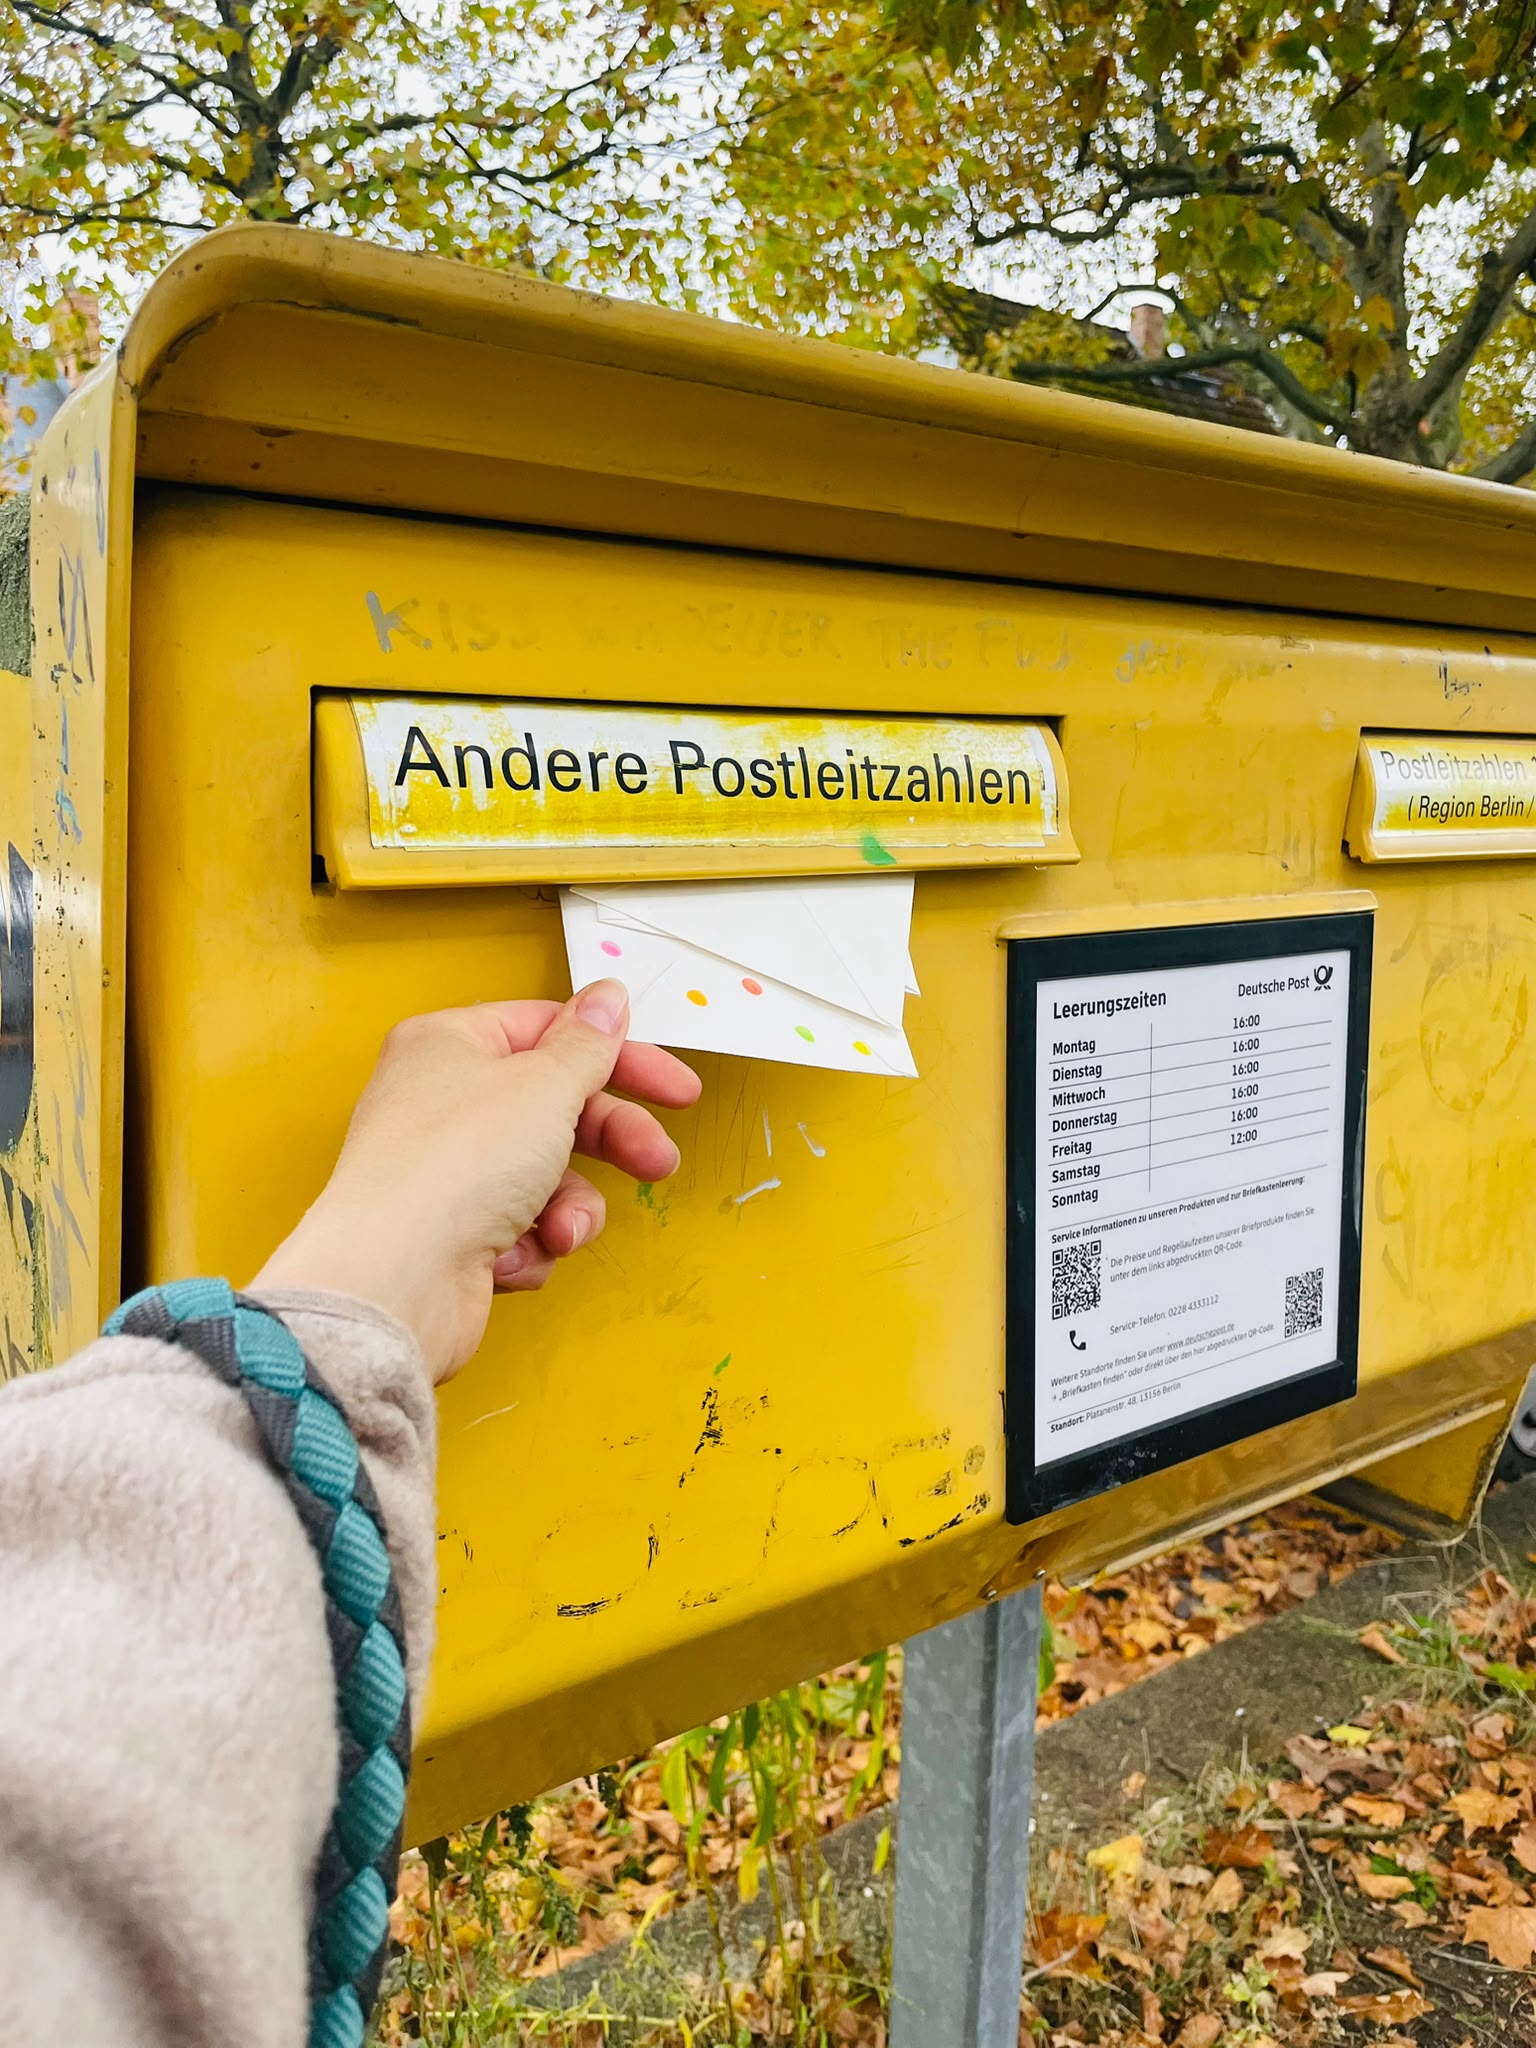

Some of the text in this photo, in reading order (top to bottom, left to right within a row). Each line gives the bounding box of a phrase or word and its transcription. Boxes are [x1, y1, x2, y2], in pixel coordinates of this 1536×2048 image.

[395, 725, 1032, 805] Andere Postleitzahlen
[1380, 750, 1528, 781] Postleitzahlen
[1480, 795, 1524, 817] Berlin
[1053, 989, 1167, 1020] Leerungszeiten
[1238, 975, 1310, 997] Deutsche Post
[1052, 1014, 1260, 1056] Montag 16:00
[1052, 1037, 1260, 1083] Dienstag 16:00
[1052, 1060, 1259, 1108] Mittwoch 16:00
[1052, 1083, 1259, 1133] Donnerstag 16:00
[1052, 1106, 1258, 1158] Freitag 16:00
[1052, 1129, 1258, 1183] Samstag 12:00
[1052, 1189, 1099, 1208] Sonntag
[1052, 1176, 1305, 1244] Service Informationen zu unseren Produkten und zur Briefkastenleerung:
[1110, 1206, 1315, 1268] Die Preise und Regellaufzeiten unserer Briefprodukte finden Sie
[1110, 1271, 1130, 1282] unter
[1131, 1264, 1148, 1277] dem
[1148, 1259, 1165, 1272] links
[1166, 1246, 1213, 1268] abgedruckten
[1110, 1294, 1219, 1335] Service-Telefon: 0228 4333112
[1050, 1322, 1235, 1387] Weitere Standorte finden Sie unter www.deutschepost.de
[1128, 1365, 1144, 1377] oder
[1144, 1359, 1164, 1372] direkt
[1164, 1353, 1180, 1366] über
[1180, 1349, 1193, 1360] den
[1193, 1345, 1206, 1357] hier
[1206, 1332, 1248, 1354] abgedruckten
[1050, 1415, 1085, 1433] Standort:
[1085, 1402, 1125, 1421] Platanenstr.
[1139, 1389, 1162, 1404] 13156
[1162, 1381, 1182, 1395] Berlin
